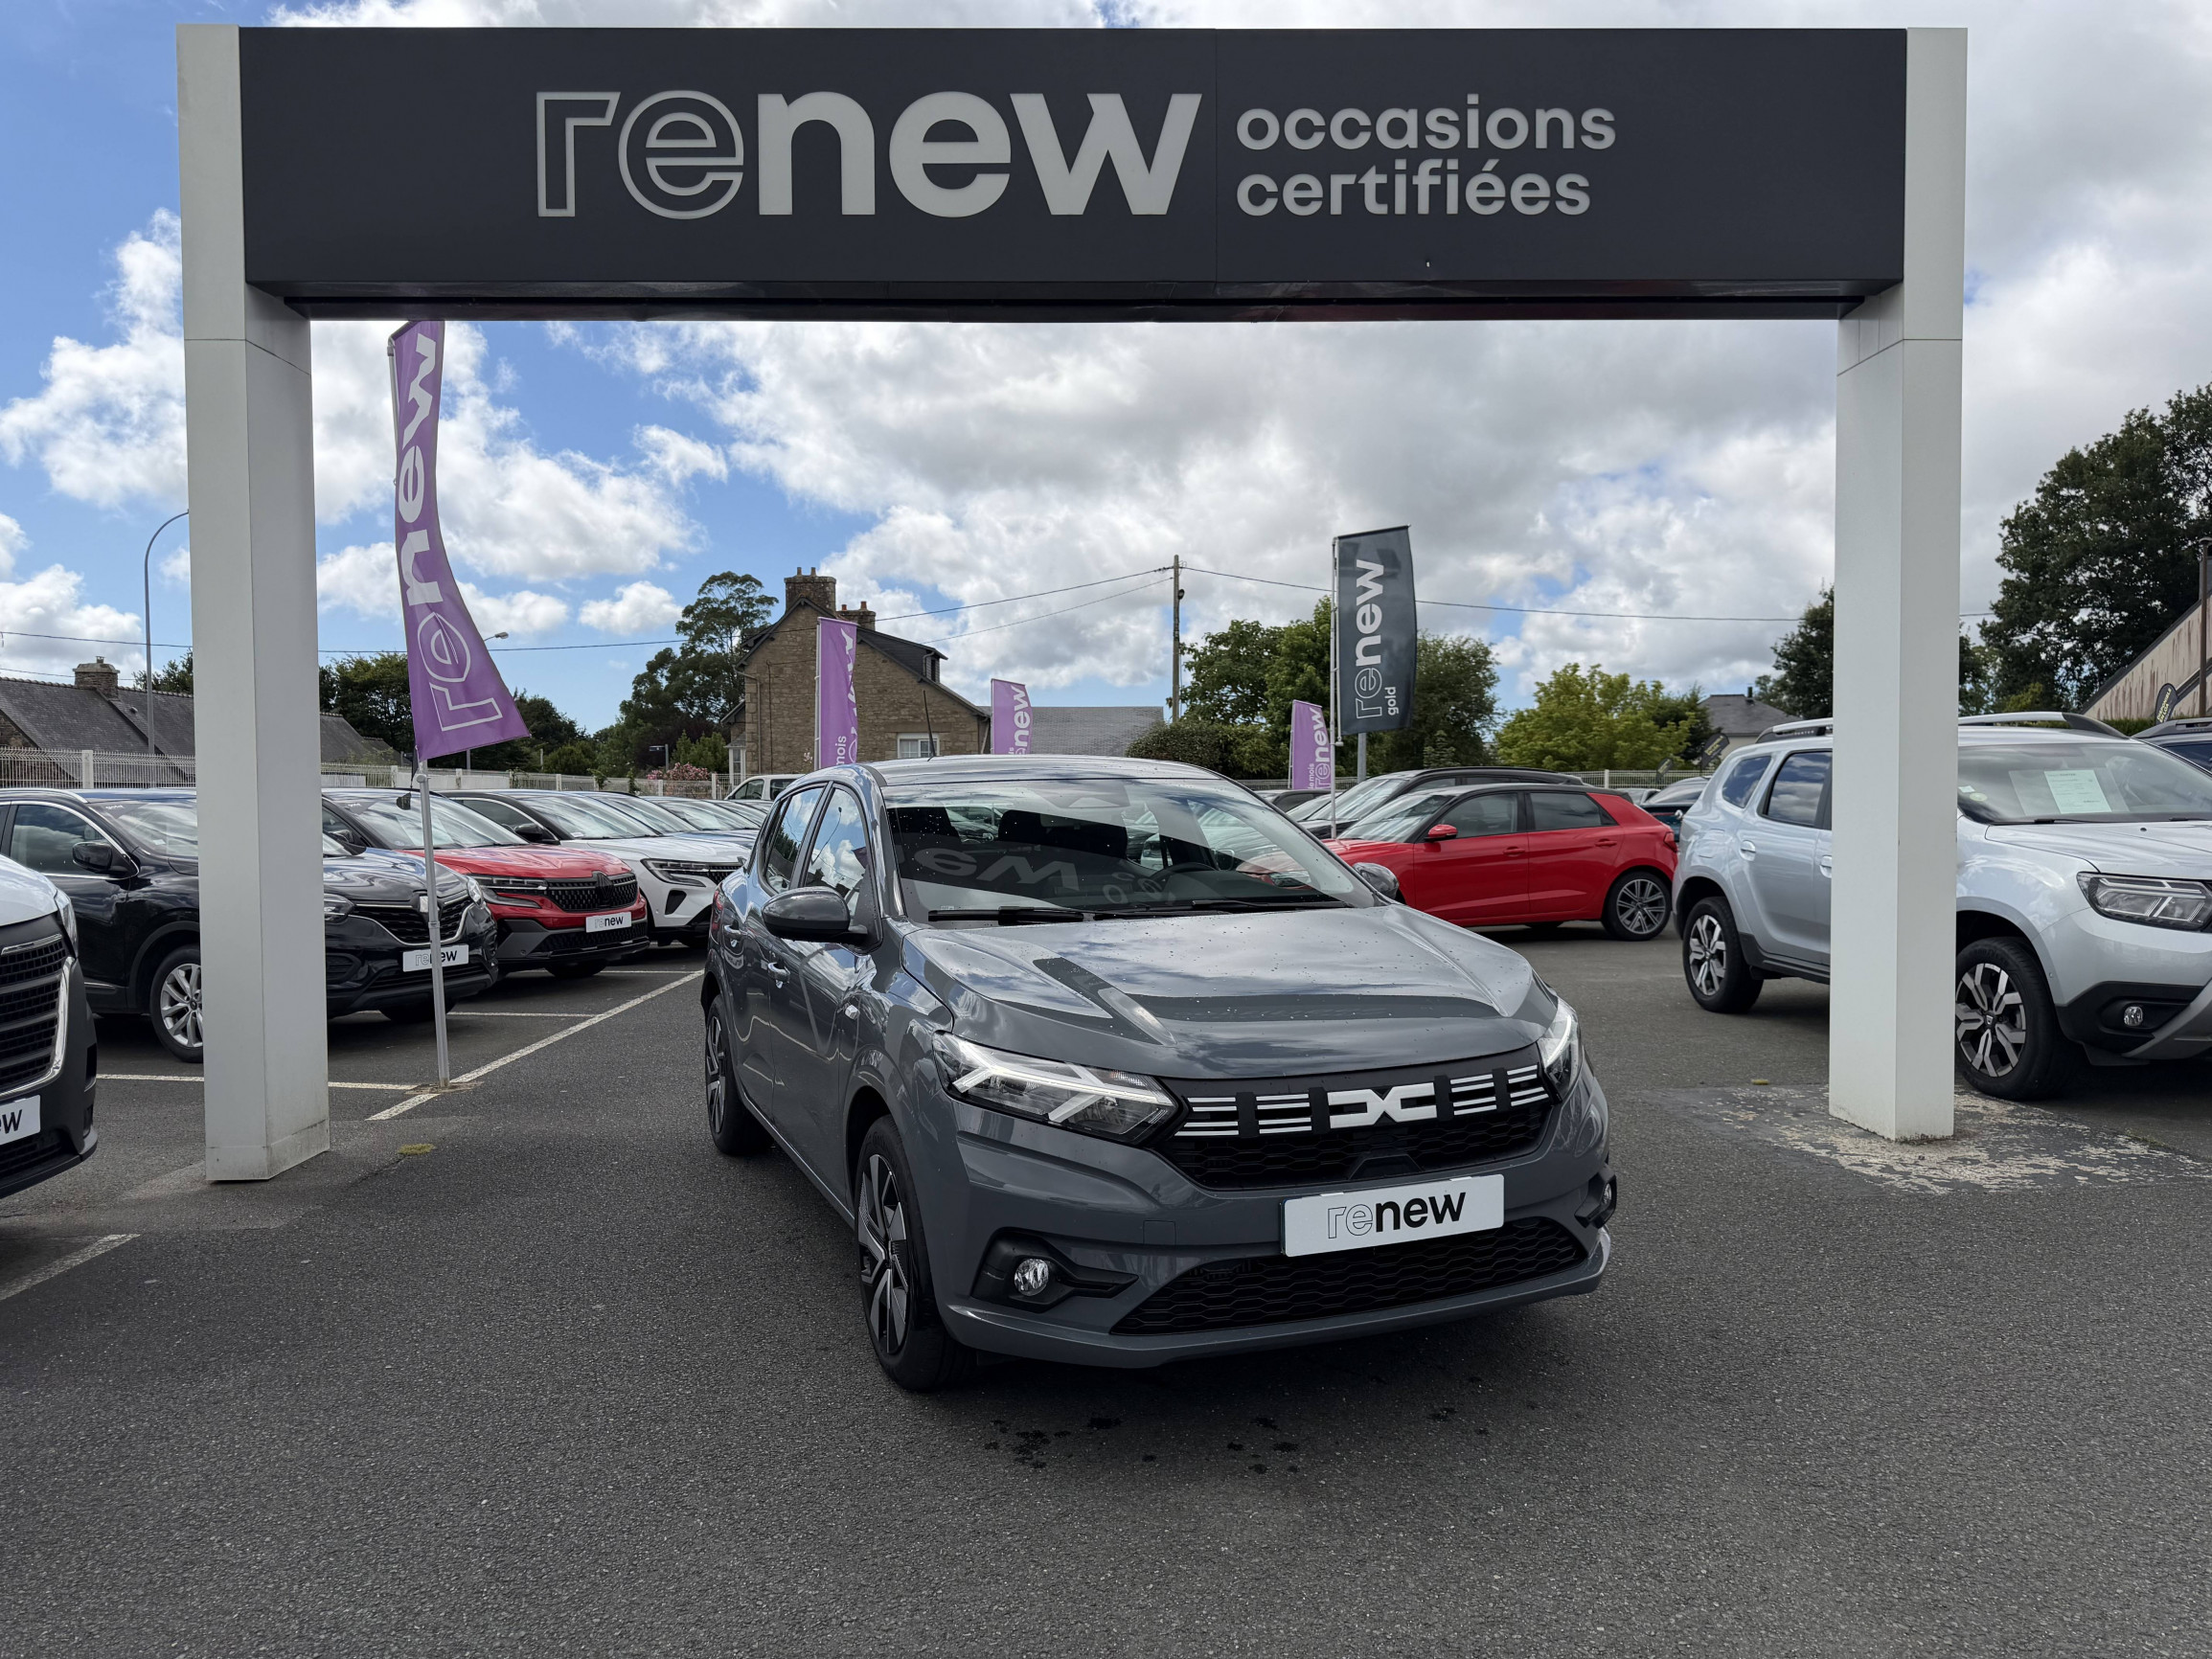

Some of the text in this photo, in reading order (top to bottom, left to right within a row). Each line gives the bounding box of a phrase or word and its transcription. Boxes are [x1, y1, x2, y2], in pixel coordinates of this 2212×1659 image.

[1236, 93, 1616, 150] occasions
[536, 90, 1203, 220] renew
[1236, 158, 1591, 217] certifiées
[398, 332, 503, 733] renew
[1355, 559, 1384, 719] renew
[1384, 686, 1400, 716] gold
[594, 915, 624, 929] renew
[415, 950, 458, 966] reew
[1327, 1192, 1467, 1239] renew
